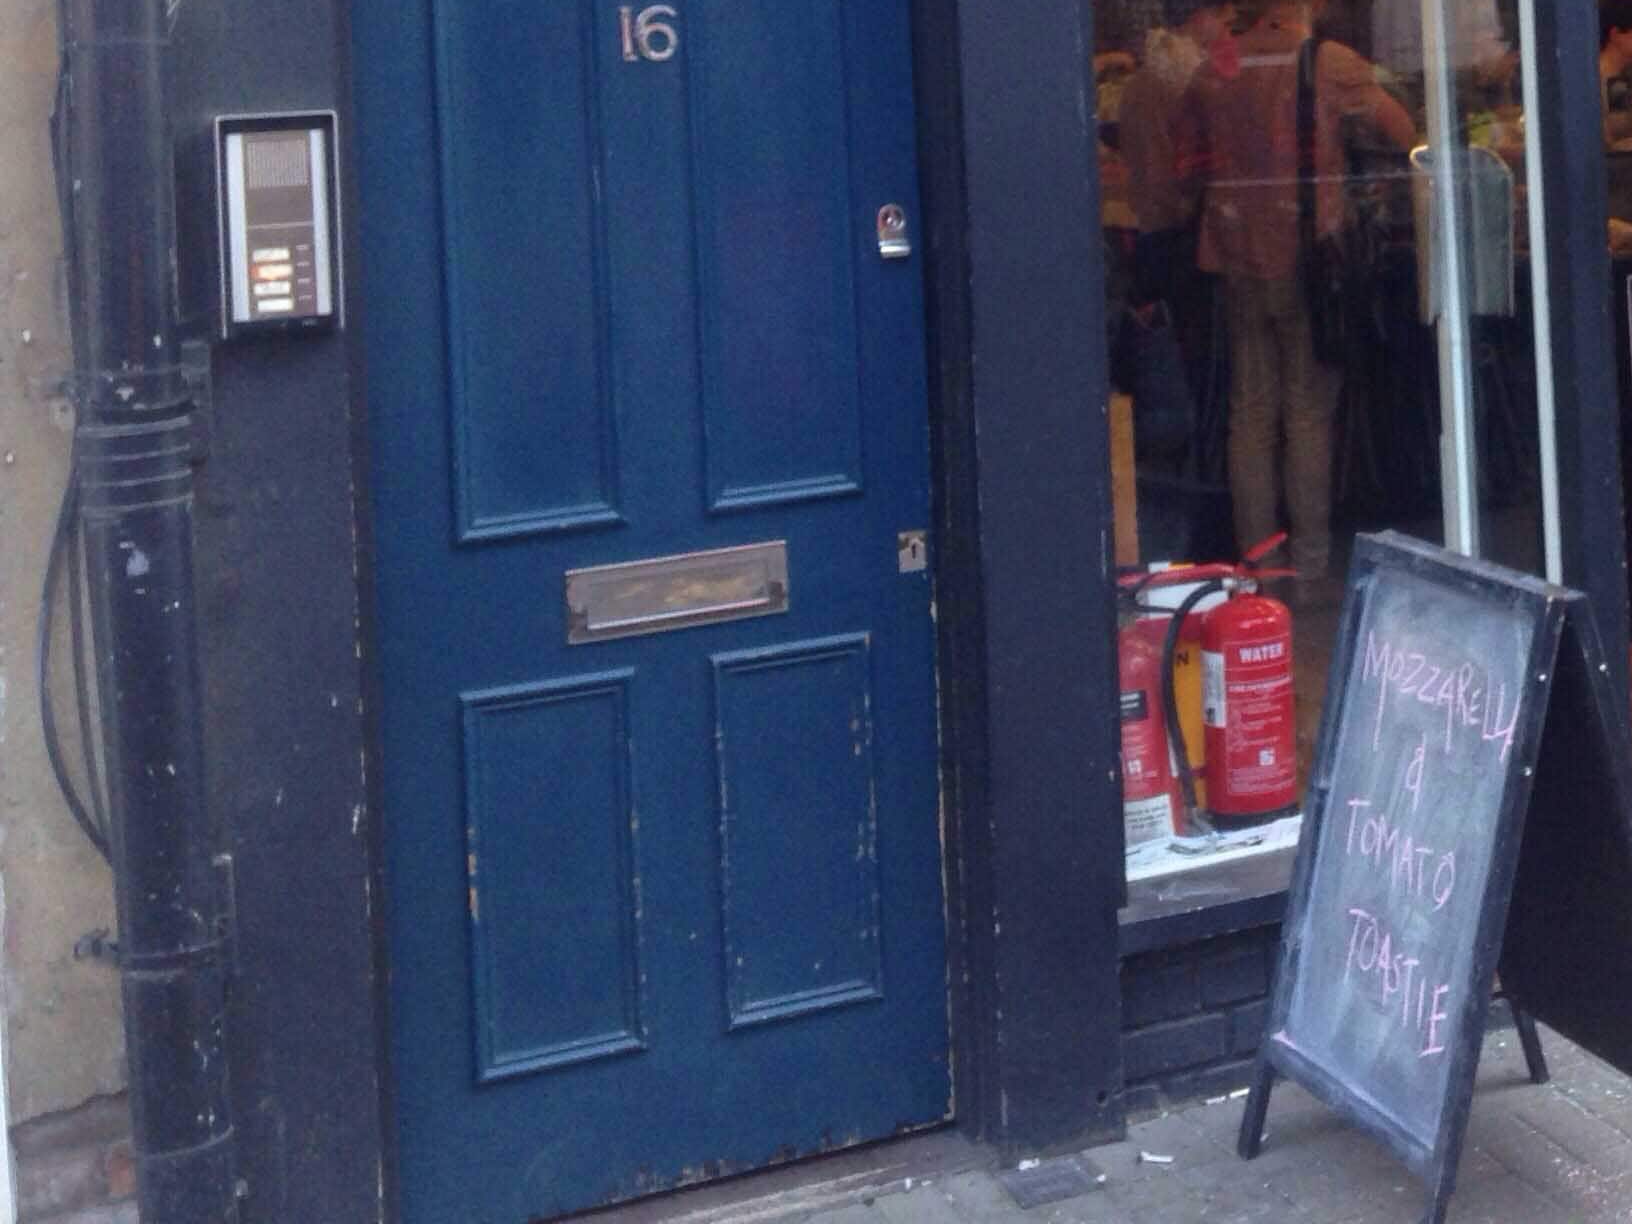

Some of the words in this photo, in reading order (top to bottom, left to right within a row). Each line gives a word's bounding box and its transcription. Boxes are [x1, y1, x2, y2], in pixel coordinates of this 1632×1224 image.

[618, 4, 680, 62] 16
[1238, 642, 1285, 664] WATER
[1346, 797, 1456, 912] TOMATO
[1343, 907, 1450, 1057] TOASTIE
